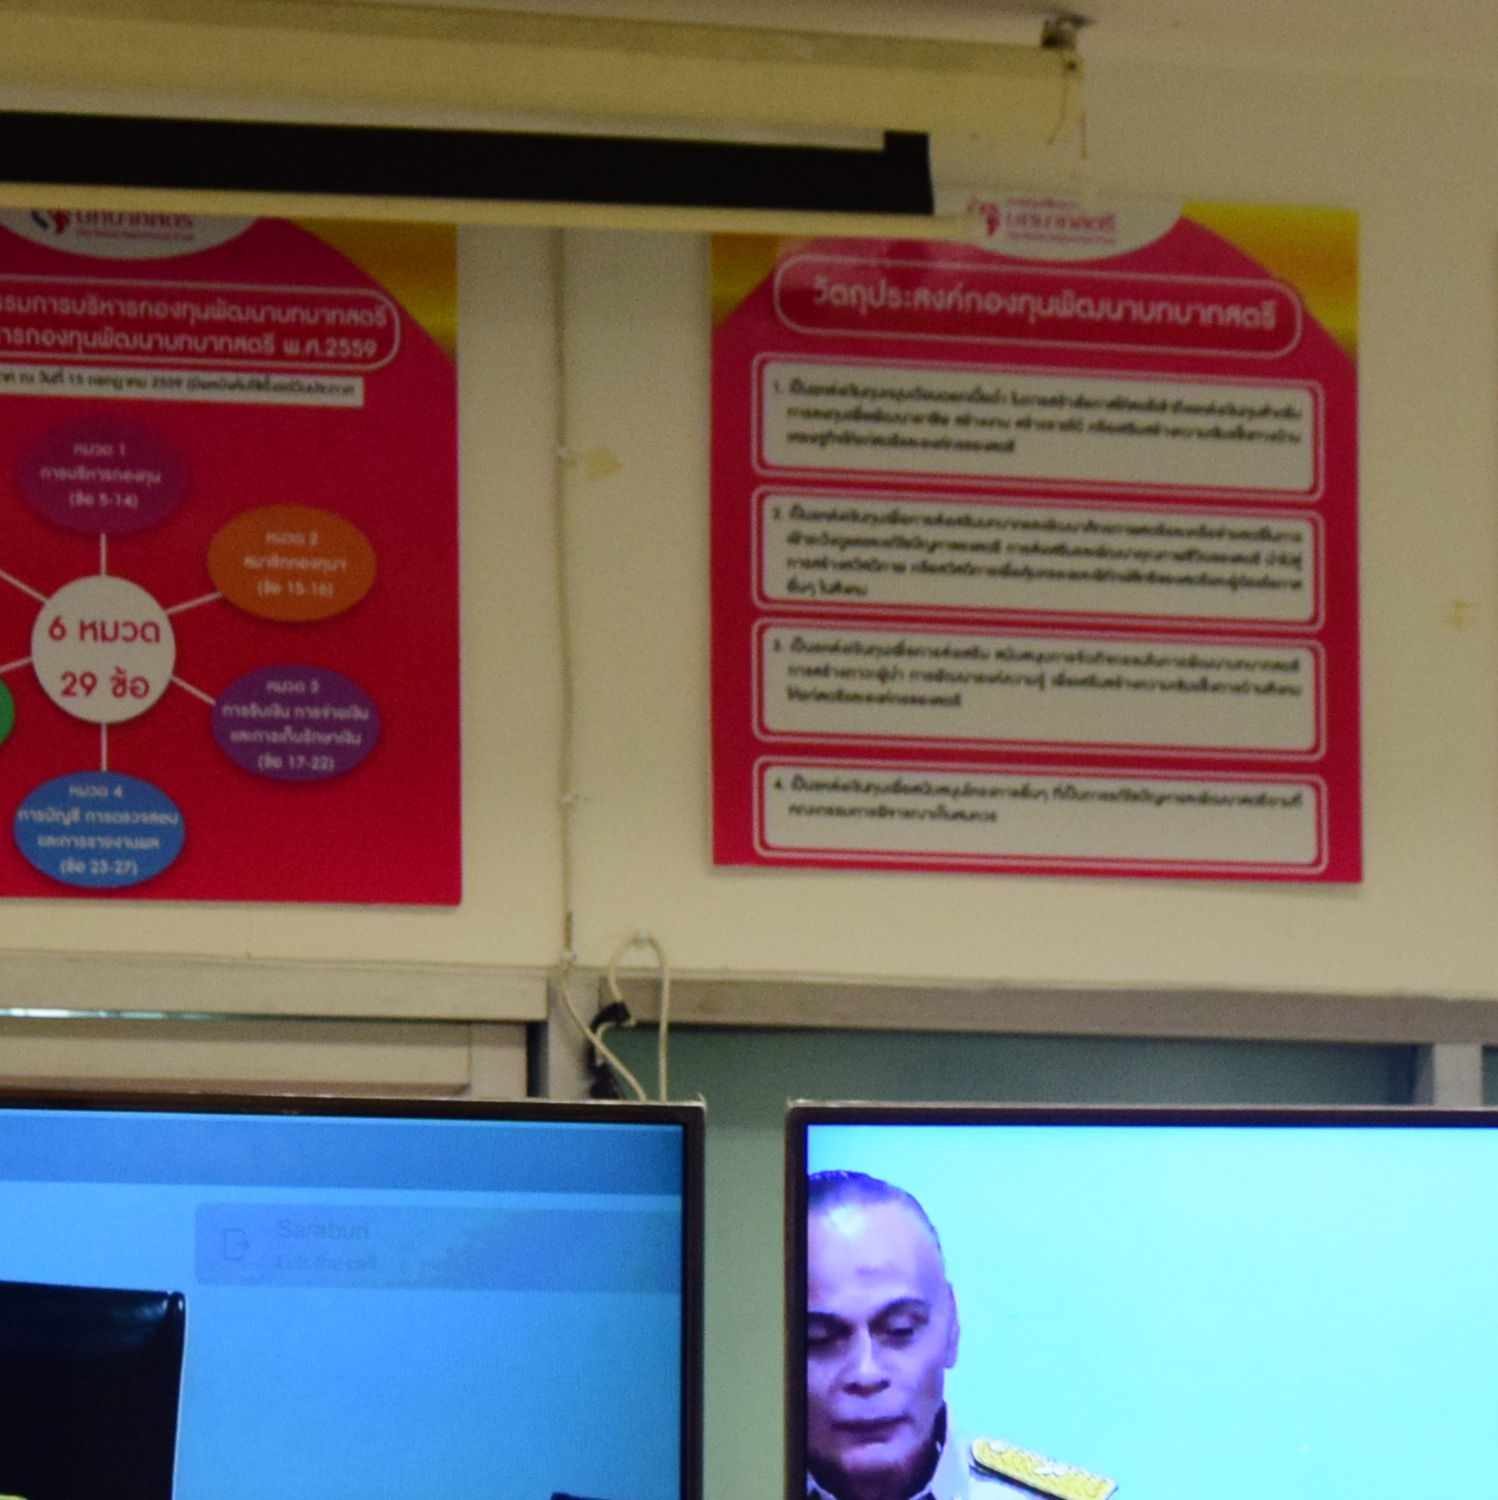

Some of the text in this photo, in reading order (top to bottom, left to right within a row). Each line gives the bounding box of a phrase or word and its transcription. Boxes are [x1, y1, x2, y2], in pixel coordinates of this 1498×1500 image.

[47, 615, 161, 645] 6 หมวด
[60, 667, 151, 700] 29 ข้อ
